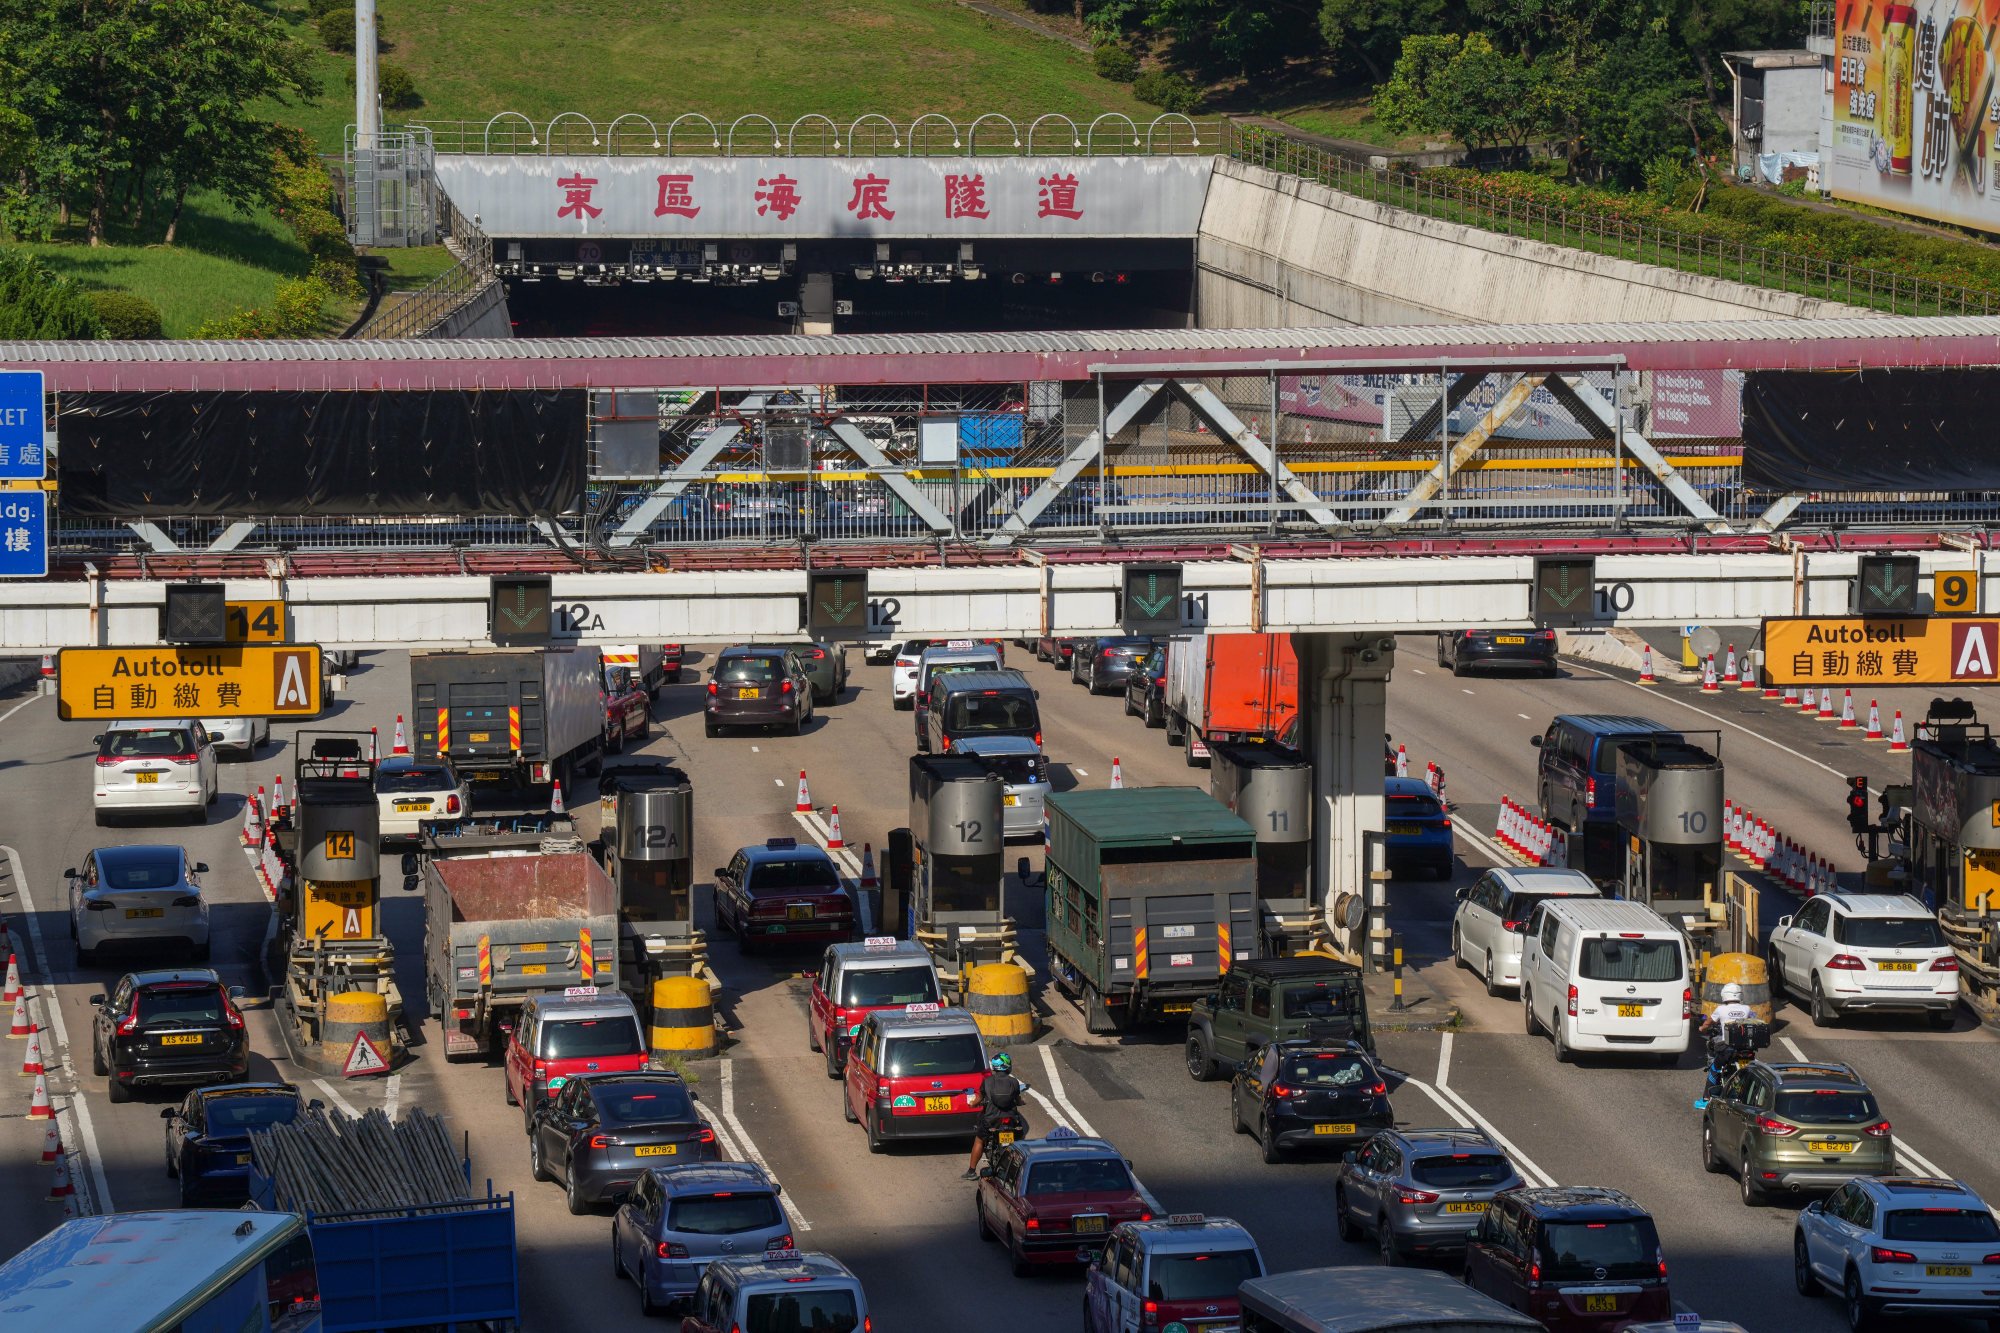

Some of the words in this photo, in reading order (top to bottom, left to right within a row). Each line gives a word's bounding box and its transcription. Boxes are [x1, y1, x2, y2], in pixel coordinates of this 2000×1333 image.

[556, 172, 1085, 221] 東區海底隧道
[632, 240, 656, 251] KEEP
[662, 240, 672, 250] IN
[582, 248, 599, 258] 70
[734, 248, 750, 258] 70
[5, 527, 31, 552] 樓
[1943, 576, 1968, 606] 9
[1594, 582, 1634, 612] 10
[1181, 592, 1208, 620] 11
[868, 598, 901, 626] 12
[230, 606, 279, 637] 14
[1806, 623, 1906, 644] Autotoll
[112, 655, 224, 677] Autotoll
[1793, 649, 1918, 677] 自動繳費
[93, 682, 241, 709] 自動繳費
[280, 806, 286, 816] E
[1267, 810, 1288, 831] 11
[1678, 811, 1707, 833] 10
[956, 820, 983, 842] 12
[329, 833, 351, 855] 14
[320, 881, 357, 889] Autotoll
[1897, 963, 1913, 971] 688
[568, 988, 596, 996] TAXI
[909, 1004, 938, 1012] TAXI
[1620, 1010, 1642, 1018] 7063
[166, 1036, 177, 1044] XS
[179, 1035, 199, 1044] 9415
[928, 1103, 950, 1112] 3680
[1319, 1125, 1330, 1133] TT
[1332, 1125, 1352, 1133] 1956
[639, 1147, 651, 1156] YR
[652, 1146, 673, 1155] 4782
[1812, 1142, 1824, 1150] SL
[1827, 1142, 1851, 1151] 6276
[1450, 1204, 1462, 1213] UH
[1171, 1215, 1203, 1224] TAXI
[767, 1250, 800, 1259] TAXI
[1678, 1315, 1699, 1323] TAXI
